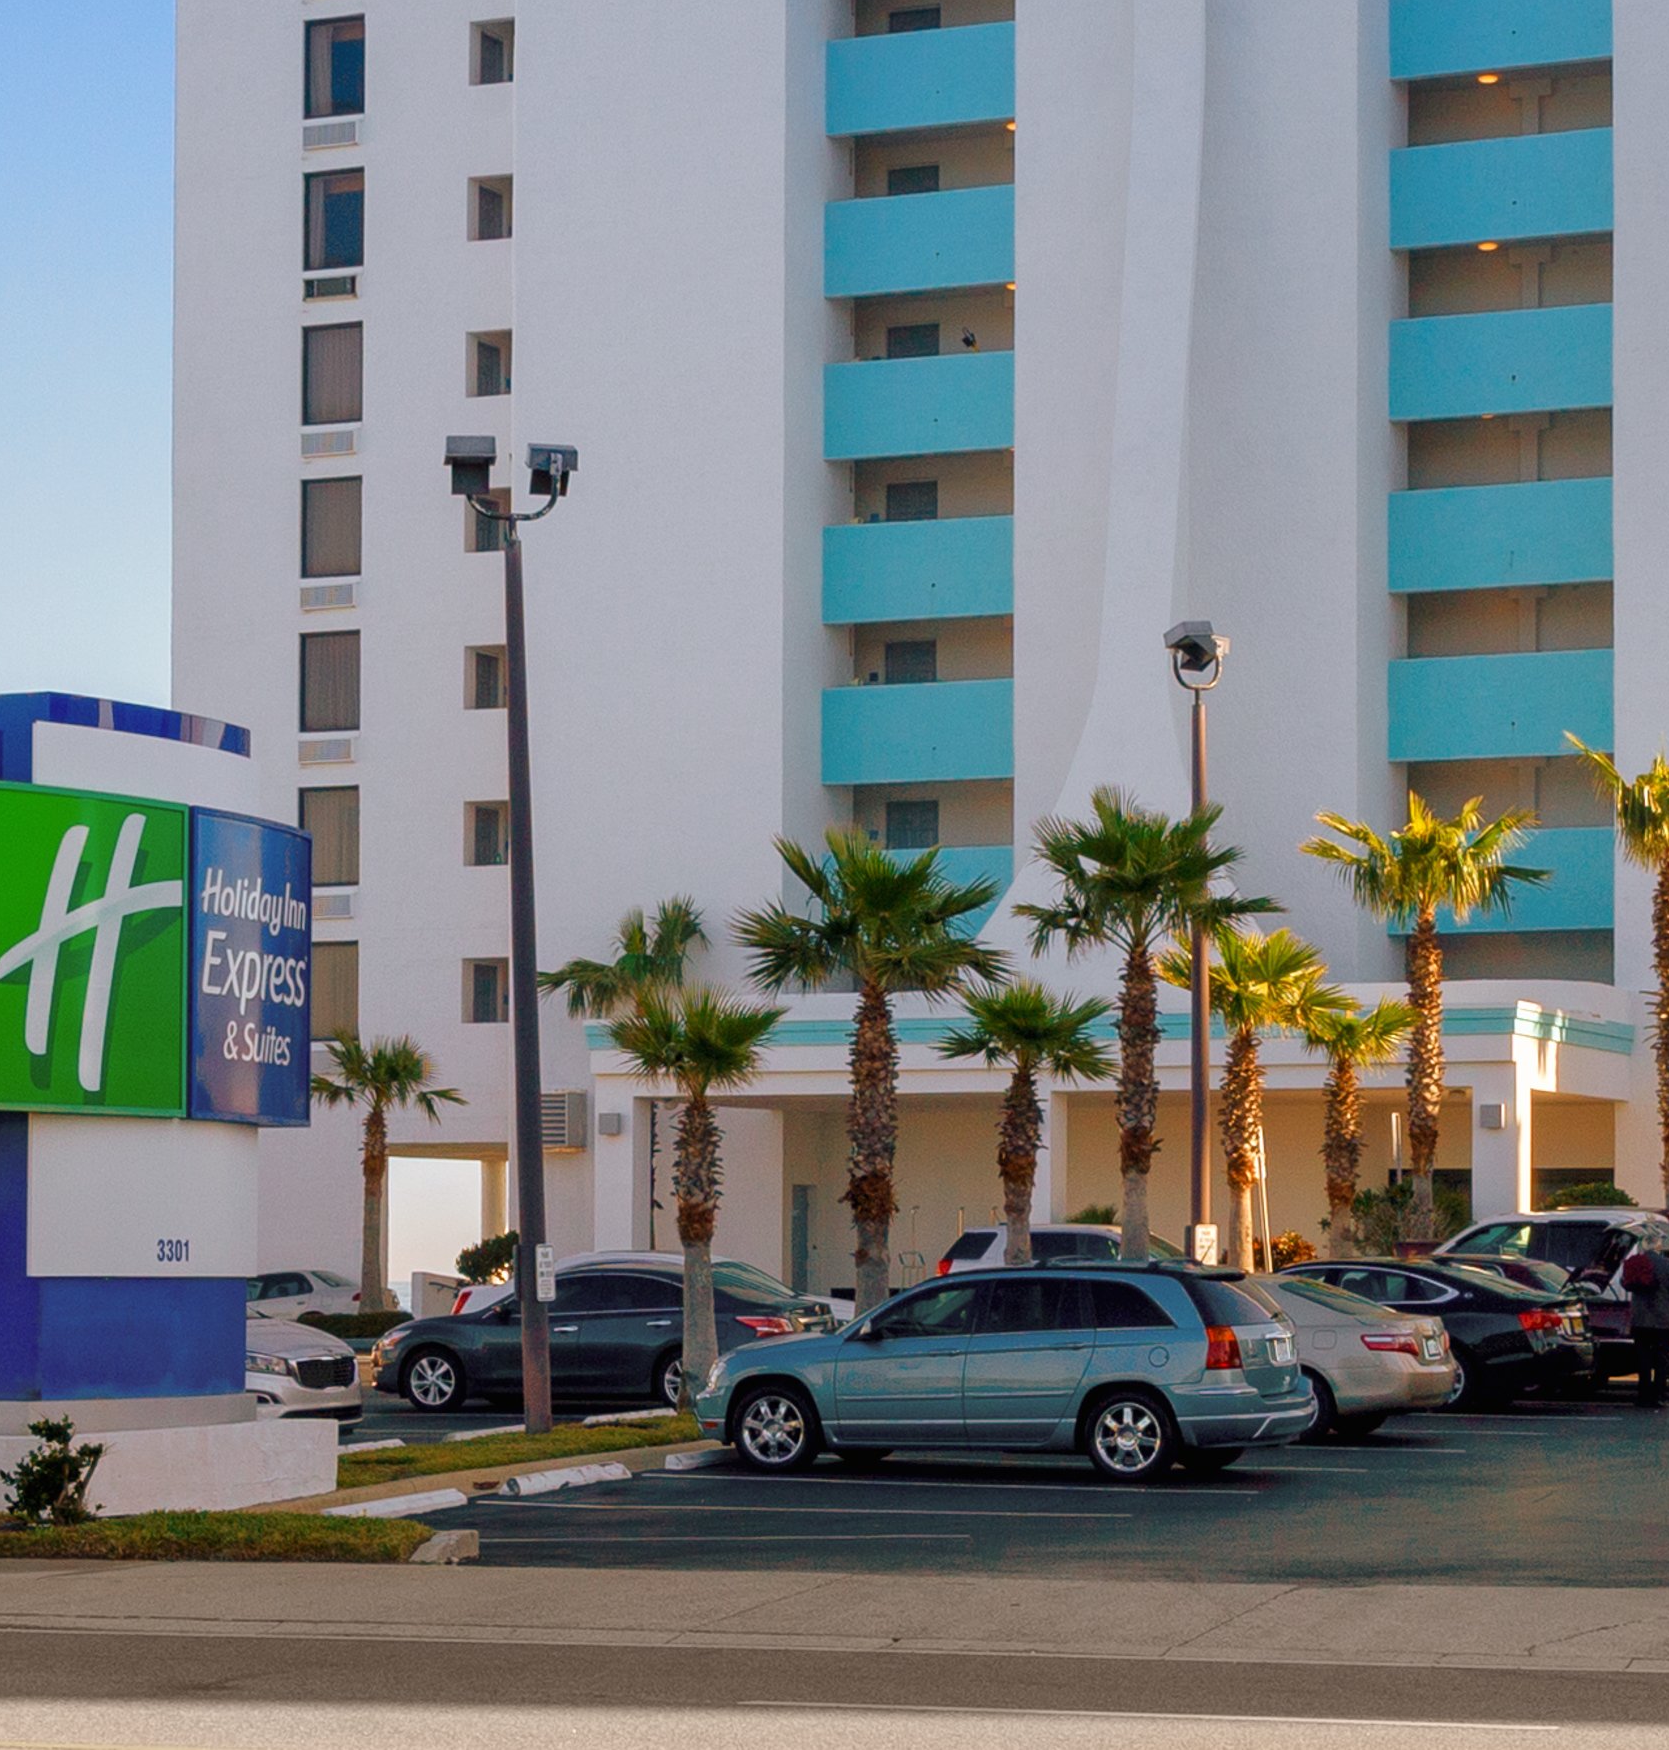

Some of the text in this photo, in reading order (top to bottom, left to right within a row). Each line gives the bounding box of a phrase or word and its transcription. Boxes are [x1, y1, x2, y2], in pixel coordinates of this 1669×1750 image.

[201, 867, 307, 936] Holiday Inn
[202, 930, 306, 1016] Express
[223, 1020, 291, 1066] & Suites
[156, 1239, 189, 1262] 3301
